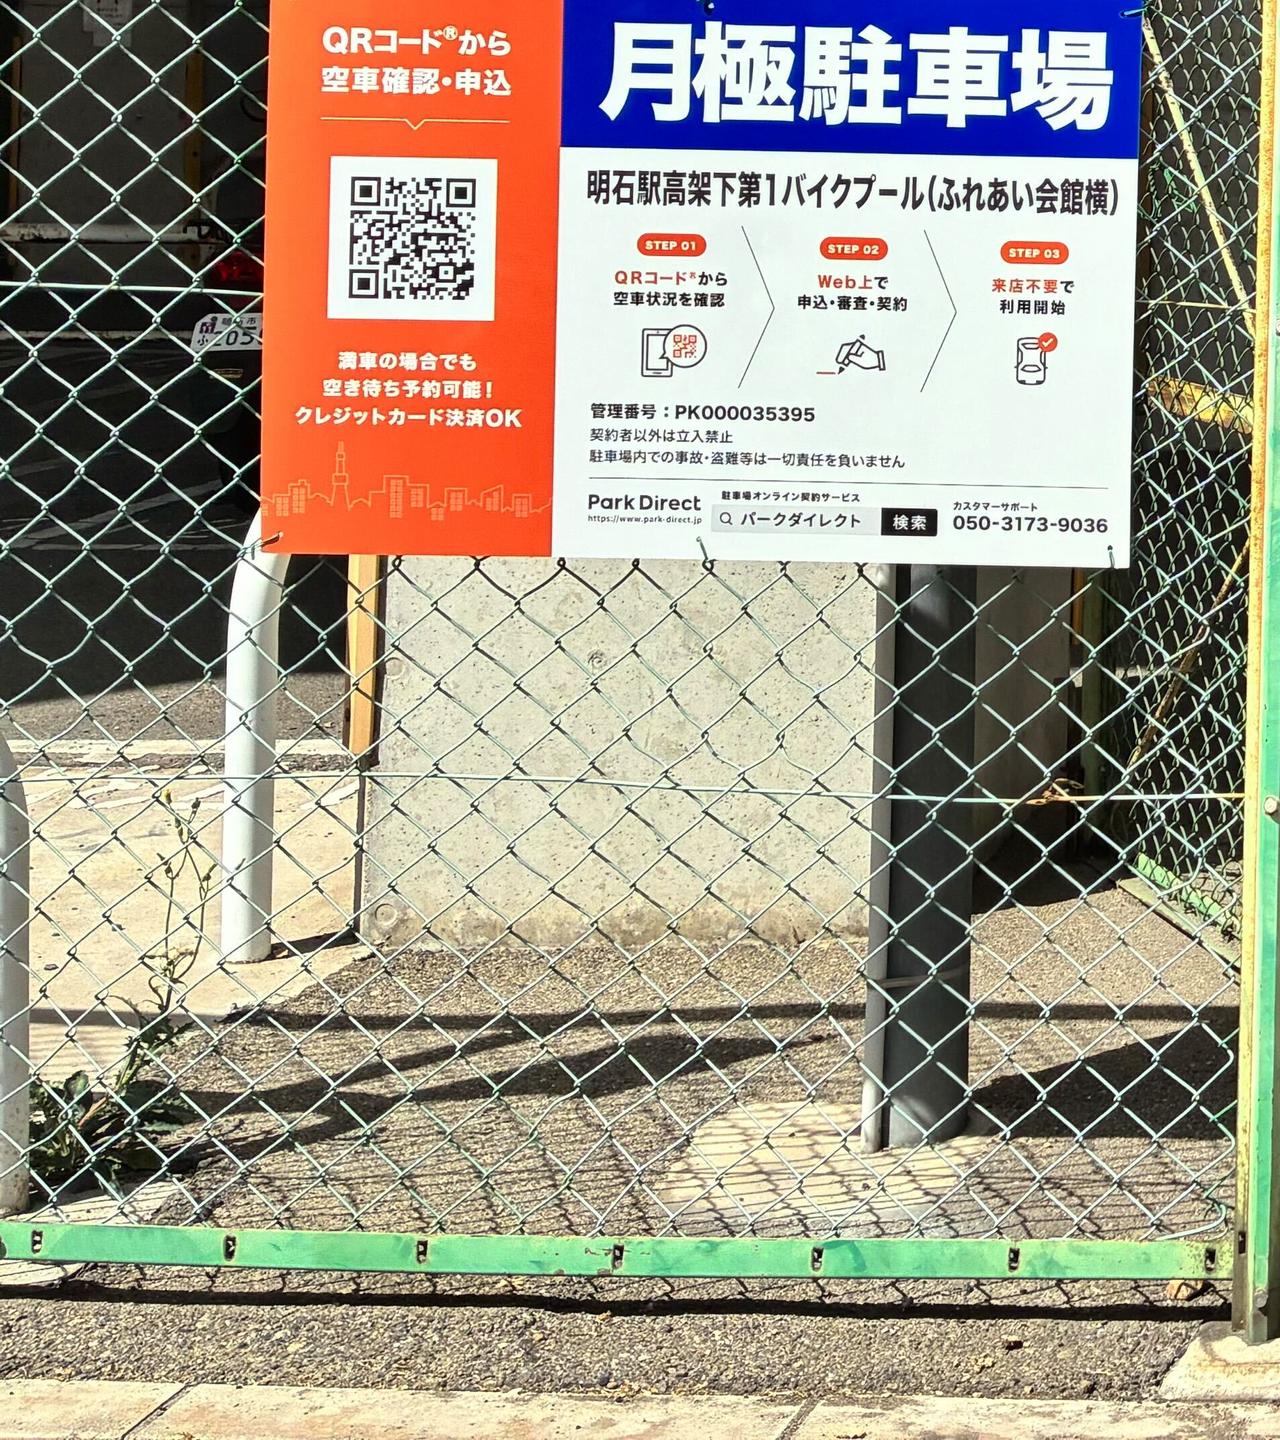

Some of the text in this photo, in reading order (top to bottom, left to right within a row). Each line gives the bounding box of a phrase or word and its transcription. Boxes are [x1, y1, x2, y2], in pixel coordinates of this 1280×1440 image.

[321, 66, 512, 97] 空車確認・申込
[598, 20, 1115, 132] 月極駐車場
[644, 240, 697, 252] STEP 01
[827, 243, 880, 255] STEP 02
[1008, 247, 1061, 260] STEP 03
[817, 274, 889, 290] Web上で
[991, 278, 1075, 295] 来店不要で
[613, 291, 726, 308] 空車状況を確認
[797, 295, 908, 312] 申込・審査・契約
[999, 299, 1065, 316] 利用開始
[338, 351, 478, 372] 満車の場合でも
[295, 406, 522, 428] クレジットカード決済OK
[589, 428, 734, 445] 契約者以外は立入禁止
[589, 449, 906, 469] 駐車場内での事故・盗難等は一切責任を負いません
[588, 494, 702, 512] Park Direct
[721, 490, 861, 504] 駐車場オンライン契約サービス
[953, 501, 1039, 513] カスタマーサポート
[587, 513, 703, 526] https://www.park-direct.jp
[740, 512, 862, 529] パークダイレクト
[893, 515, 927, 532] 検索
[953, 514, 1109, 534] 050-3173-9036
